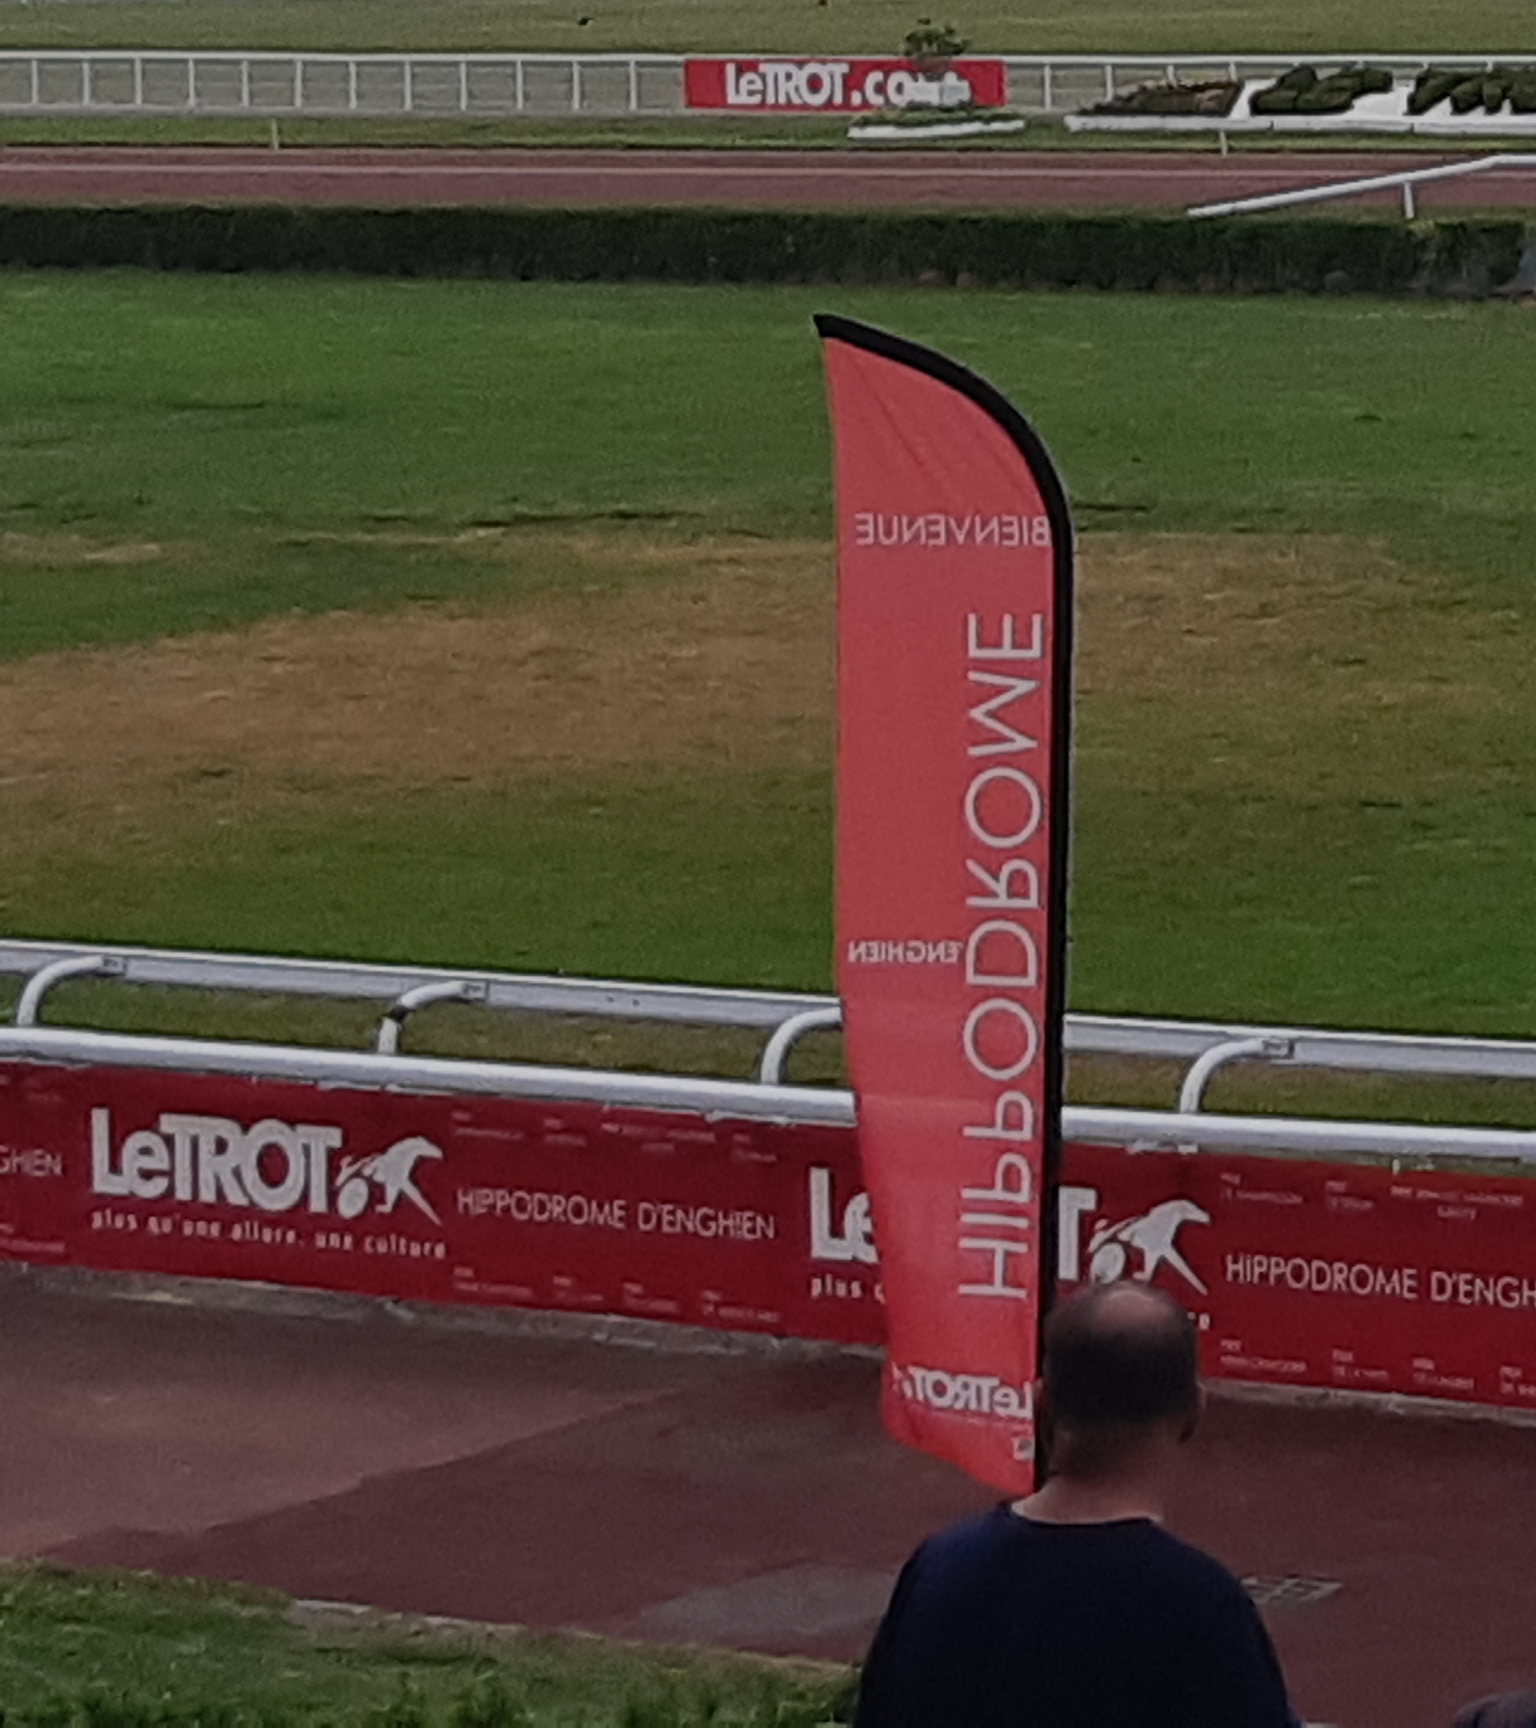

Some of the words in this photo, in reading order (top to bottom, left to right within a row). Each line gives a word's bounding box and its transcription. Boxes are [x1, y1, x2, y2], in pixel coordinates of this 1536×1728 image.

[725, 61, 972, 107] LeTROT.co
[90, 1106, 343, 1214] LeTROT
[457, 1188, 627, 1230] HIPPODROME
[638, 1201, 775, 1240] D'ENGHIEN
[811, 1274, 862, 1301] plus
[1225, 1253, 1418, 1300] HIPPODROME
